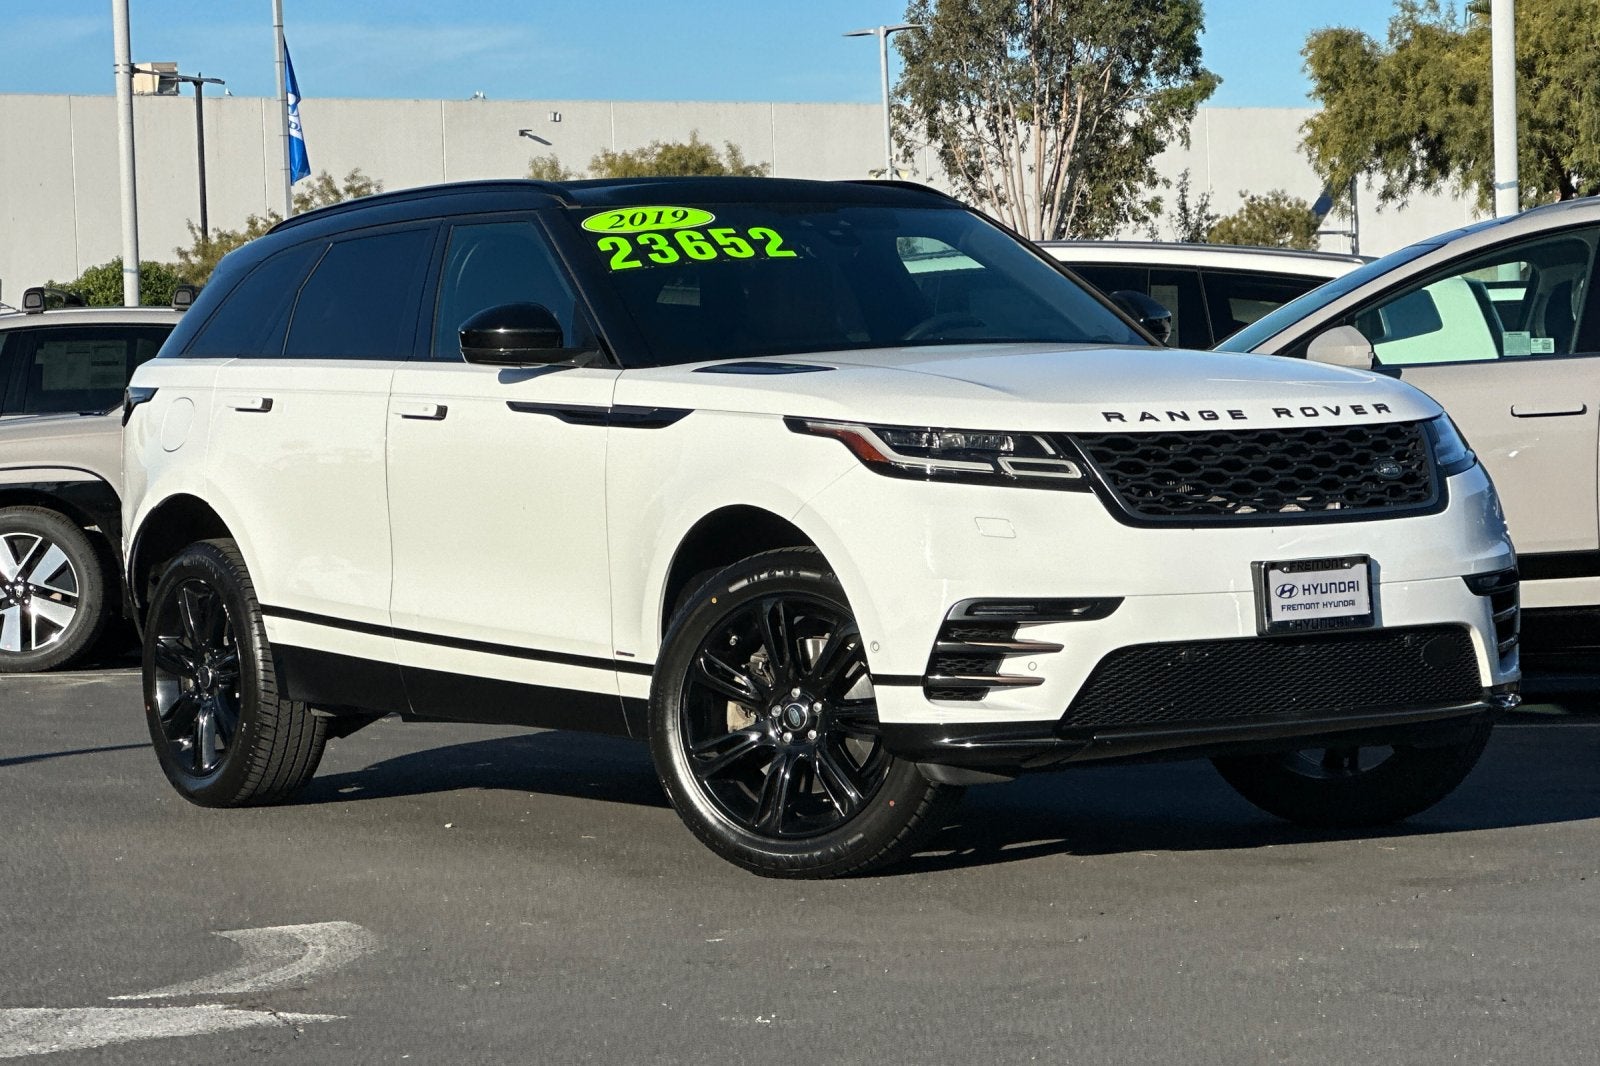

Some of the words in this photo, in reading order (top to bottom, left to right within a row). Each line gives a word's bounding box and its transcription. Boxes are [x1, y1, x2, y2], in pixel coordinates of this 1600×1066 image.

[608, 209, 689, 229] 2019
[597, 227, 797, 270] 23652
[1101, 409, 1248, 422] RANGE
[1272, 403, 1392, 418] ROVER
[1289, 559, 1345, 571] FREMONT
[1302, 580, 1360, 596] HYUNDAI
[1281, 602, 1320, 612] FREMONT
[1322, 599, 1356, 609] HYUNDAI
